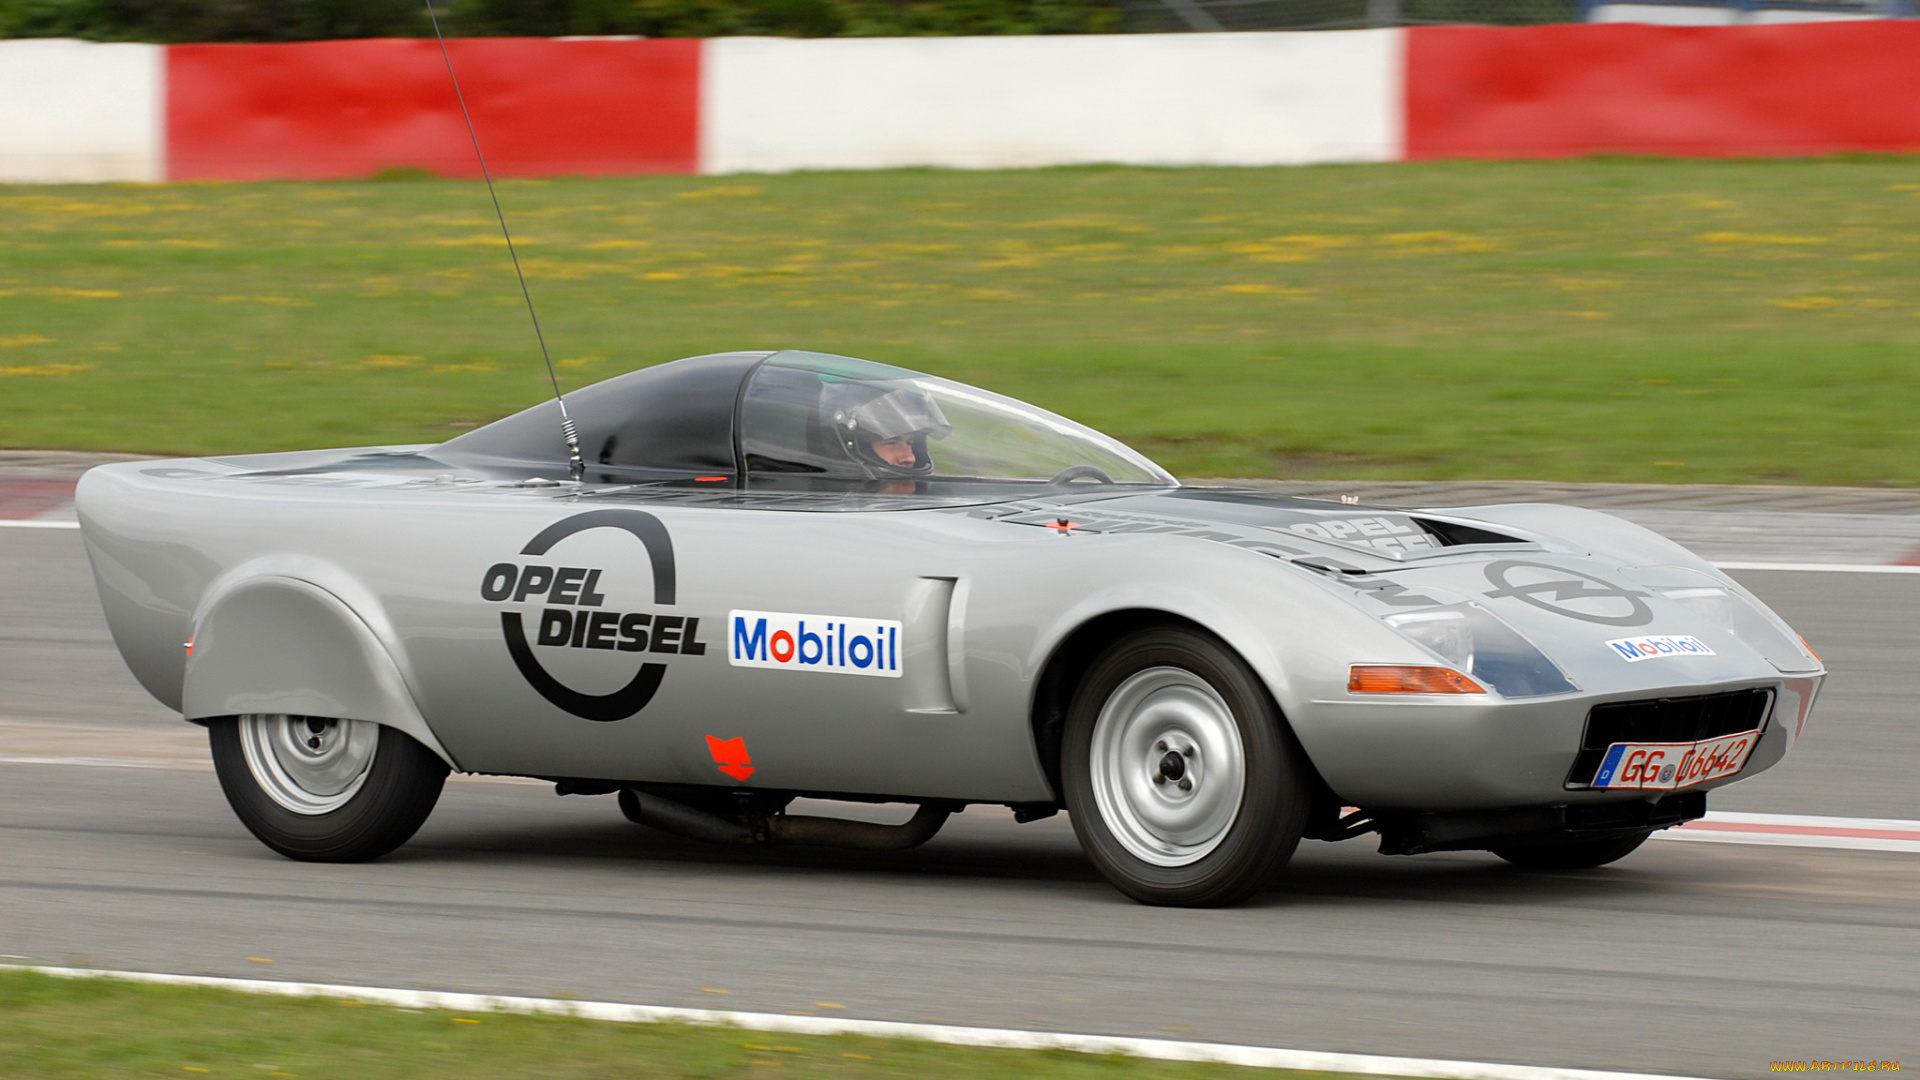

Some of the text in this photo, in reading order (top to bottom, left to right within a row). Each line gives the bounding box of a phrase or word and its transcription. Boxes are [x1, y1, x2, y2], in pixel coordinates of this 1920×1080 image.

[1289, 516, 1413, 539] OPEL
[480, 562, 606, 607] OPEL
[537, 608, 707, 656] DIESEL
[734, 616, 897, 671] Mobiloil
[1611, 637, 1711, 660] Mobiloil
[1601, 738, 1749, 782] D GG 06642
